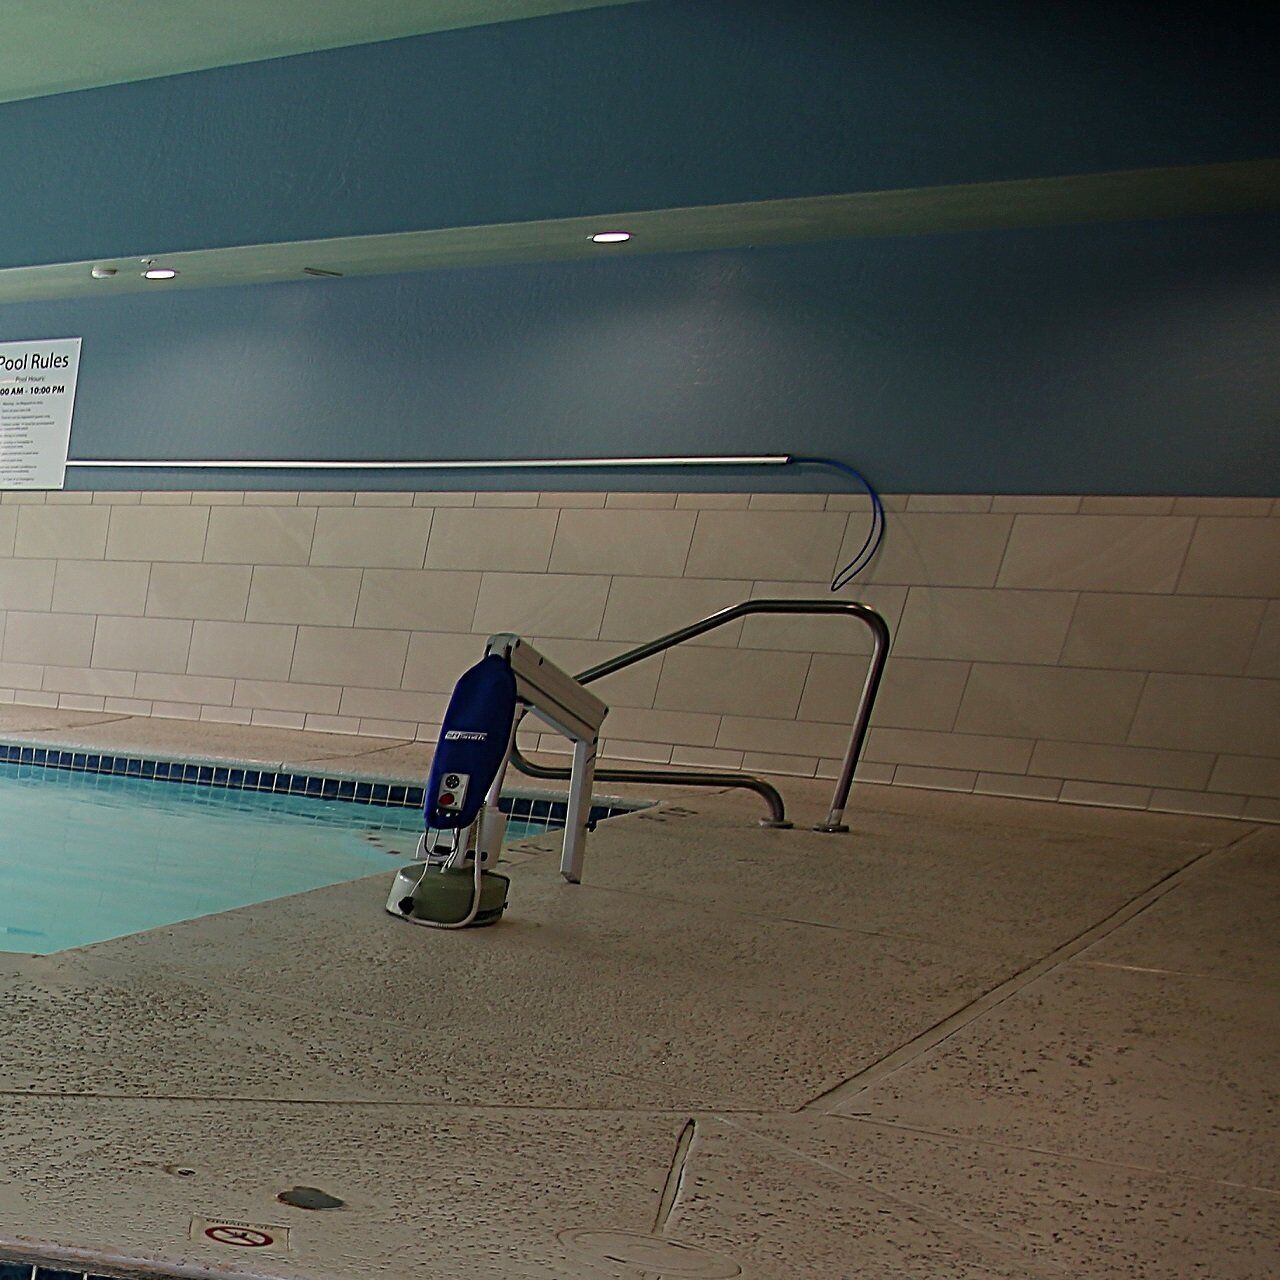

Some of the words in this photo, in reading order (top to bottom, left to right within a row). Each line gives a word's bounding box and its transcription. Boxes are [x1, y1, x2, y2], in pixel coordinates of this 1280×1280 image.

[31, 352, 69, 369] Rules
[11, 387, 24, 395] AM
[30, 386, 51, 395] 10:00
[52, 385, 65, 394] PM
